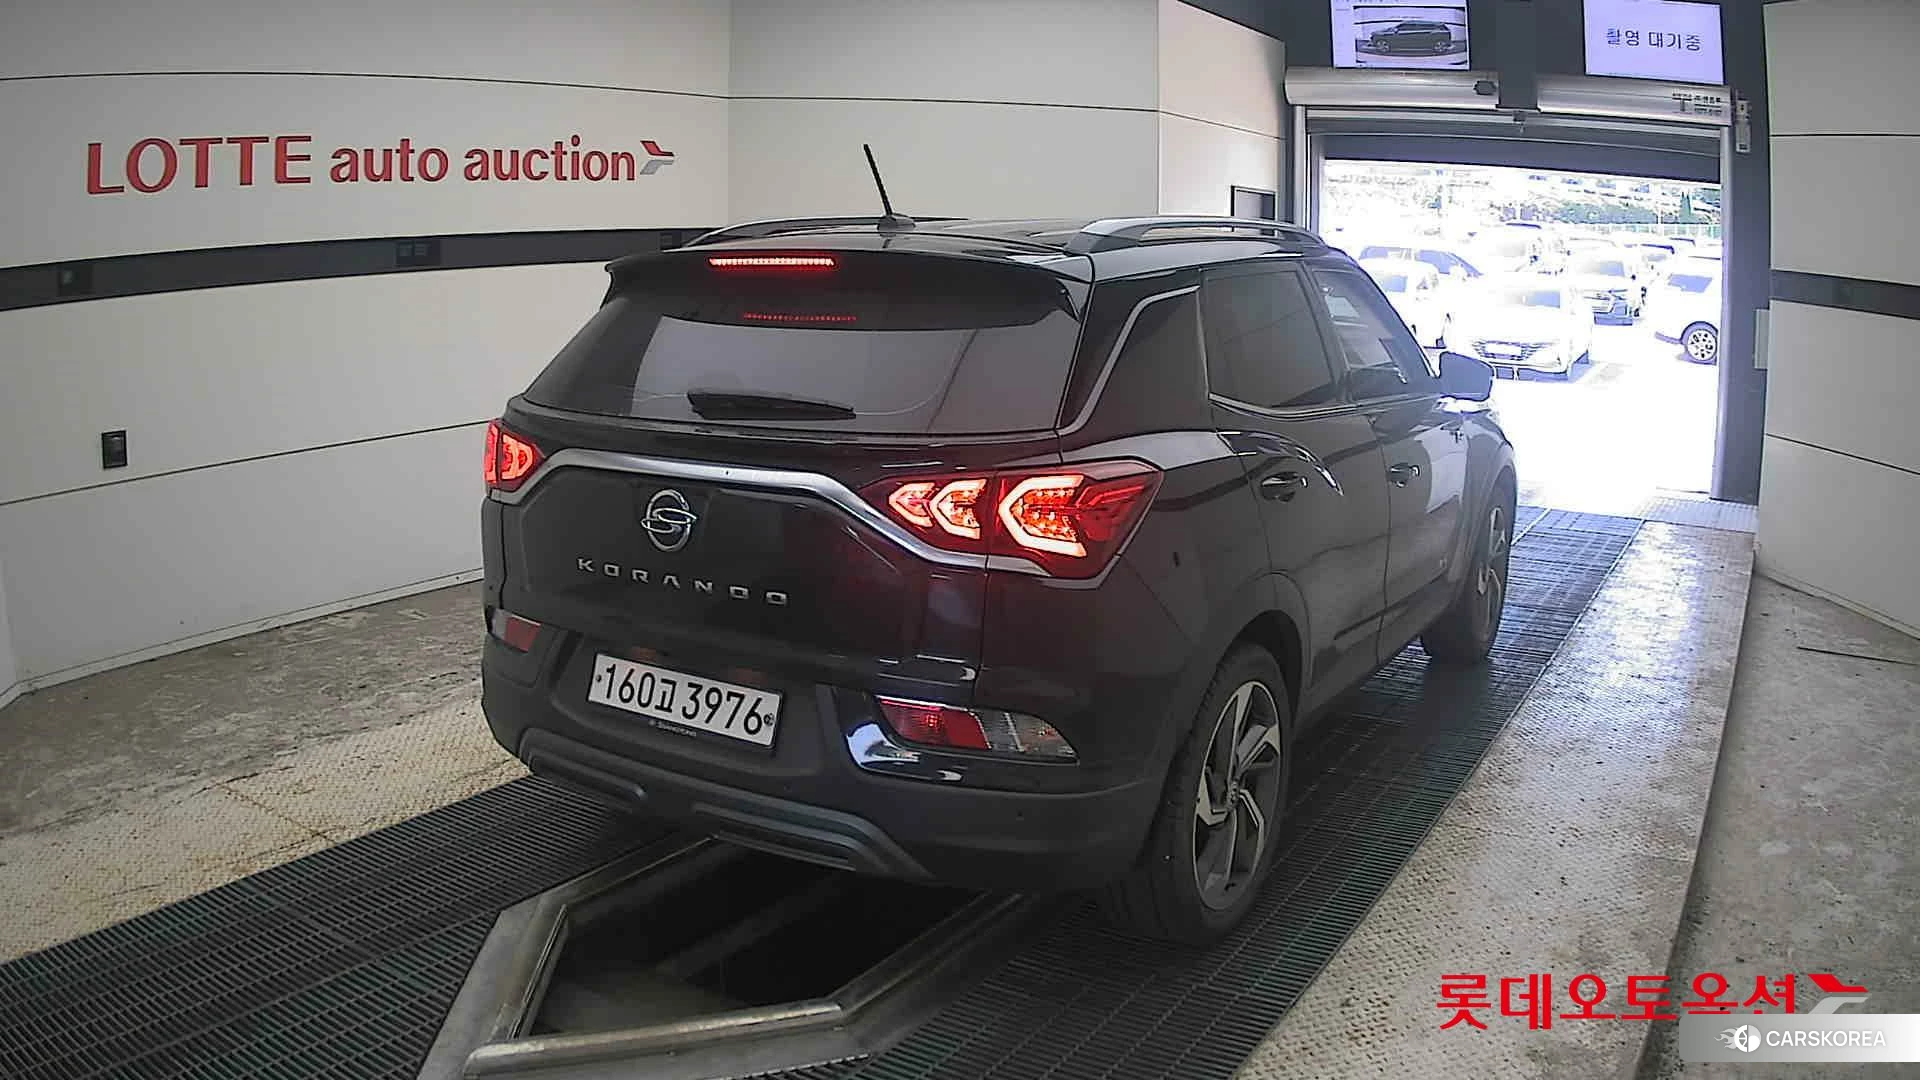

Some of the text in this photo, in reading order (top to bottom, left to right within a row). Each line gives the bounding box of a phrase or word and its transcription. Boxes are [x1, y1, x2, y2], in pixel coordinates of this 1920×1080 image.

[1648, 31, 1701, 52] 대기중
[87, 134, 636, 195] LOTTE auto auction
[577, 557, 788, 606] KORANDO
[605, 663, 764, 736] 160고 3976
